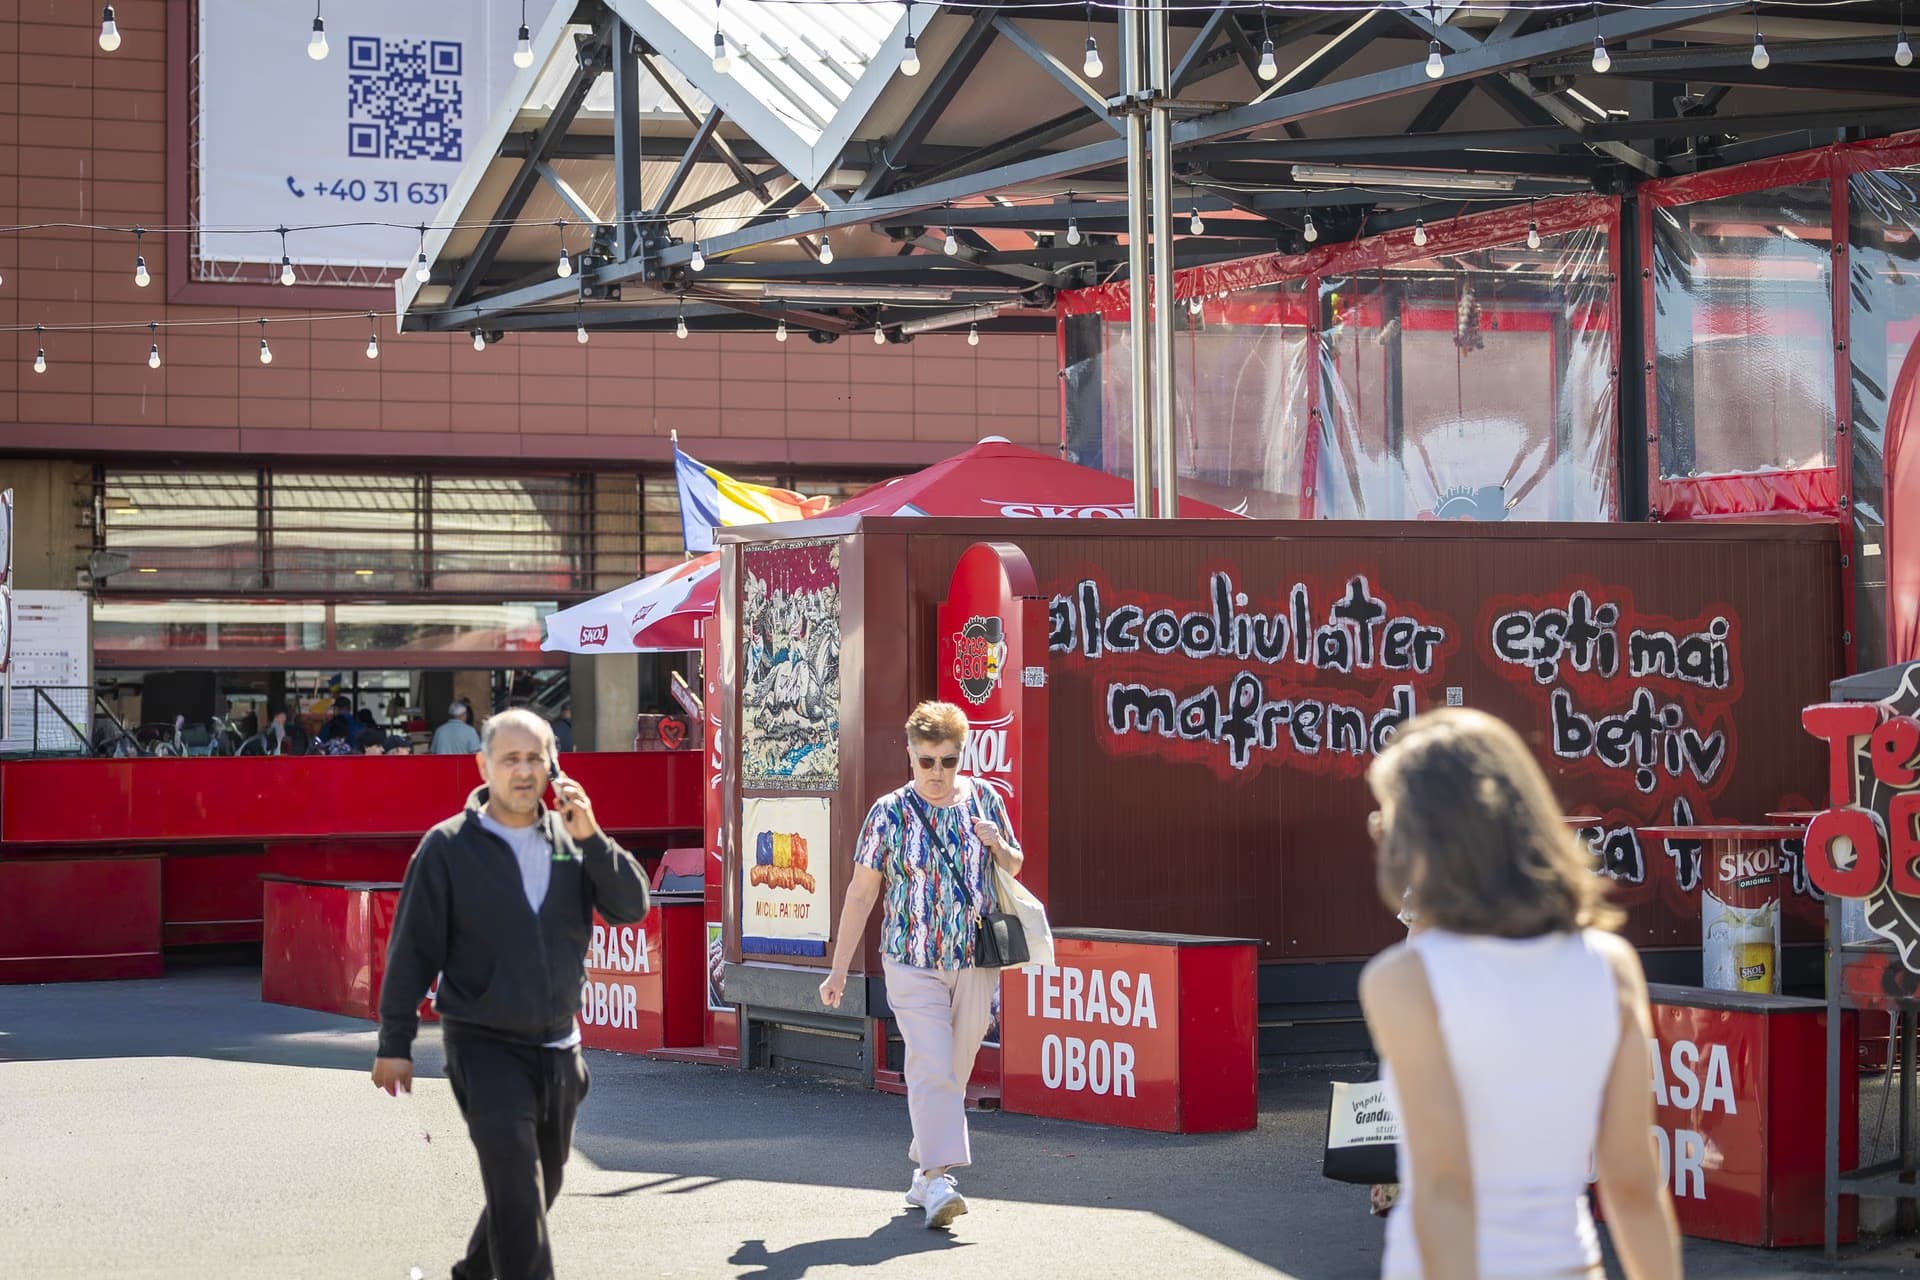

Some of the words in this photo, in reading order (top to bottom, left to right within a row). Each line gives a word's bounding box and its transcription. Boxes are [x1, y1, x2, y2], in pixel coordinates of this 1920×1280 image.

[314, 179, 366, 202] +40
[374, 180, 398, 203] 31
[407, 182, 448, 204] 631
[580, 625, 608, 644] SKOL
[1629, 616, 1729, 689] mai
[960, 730, 1012, 776] KOL
[1719, 846, 1780, 881] SKOL
[1740, 876, 1771, 888] ORIGINAL
[756, 900, 778, 918] MICUL
[779, 902, 811, 919] PATRIOT
[583, 926, 650, 973] RASA
[1741, 965, 1764, 977] SKOL
[581, 982, 638, 1030] OBOR
[1021, 964, 1158, 1029] TERASA
[1041, 1034, 1137, 1098] OBOR
[1648, 1037, 1737, 1115] ASA
[1355, 1108, 1396, 1125] Grandm
